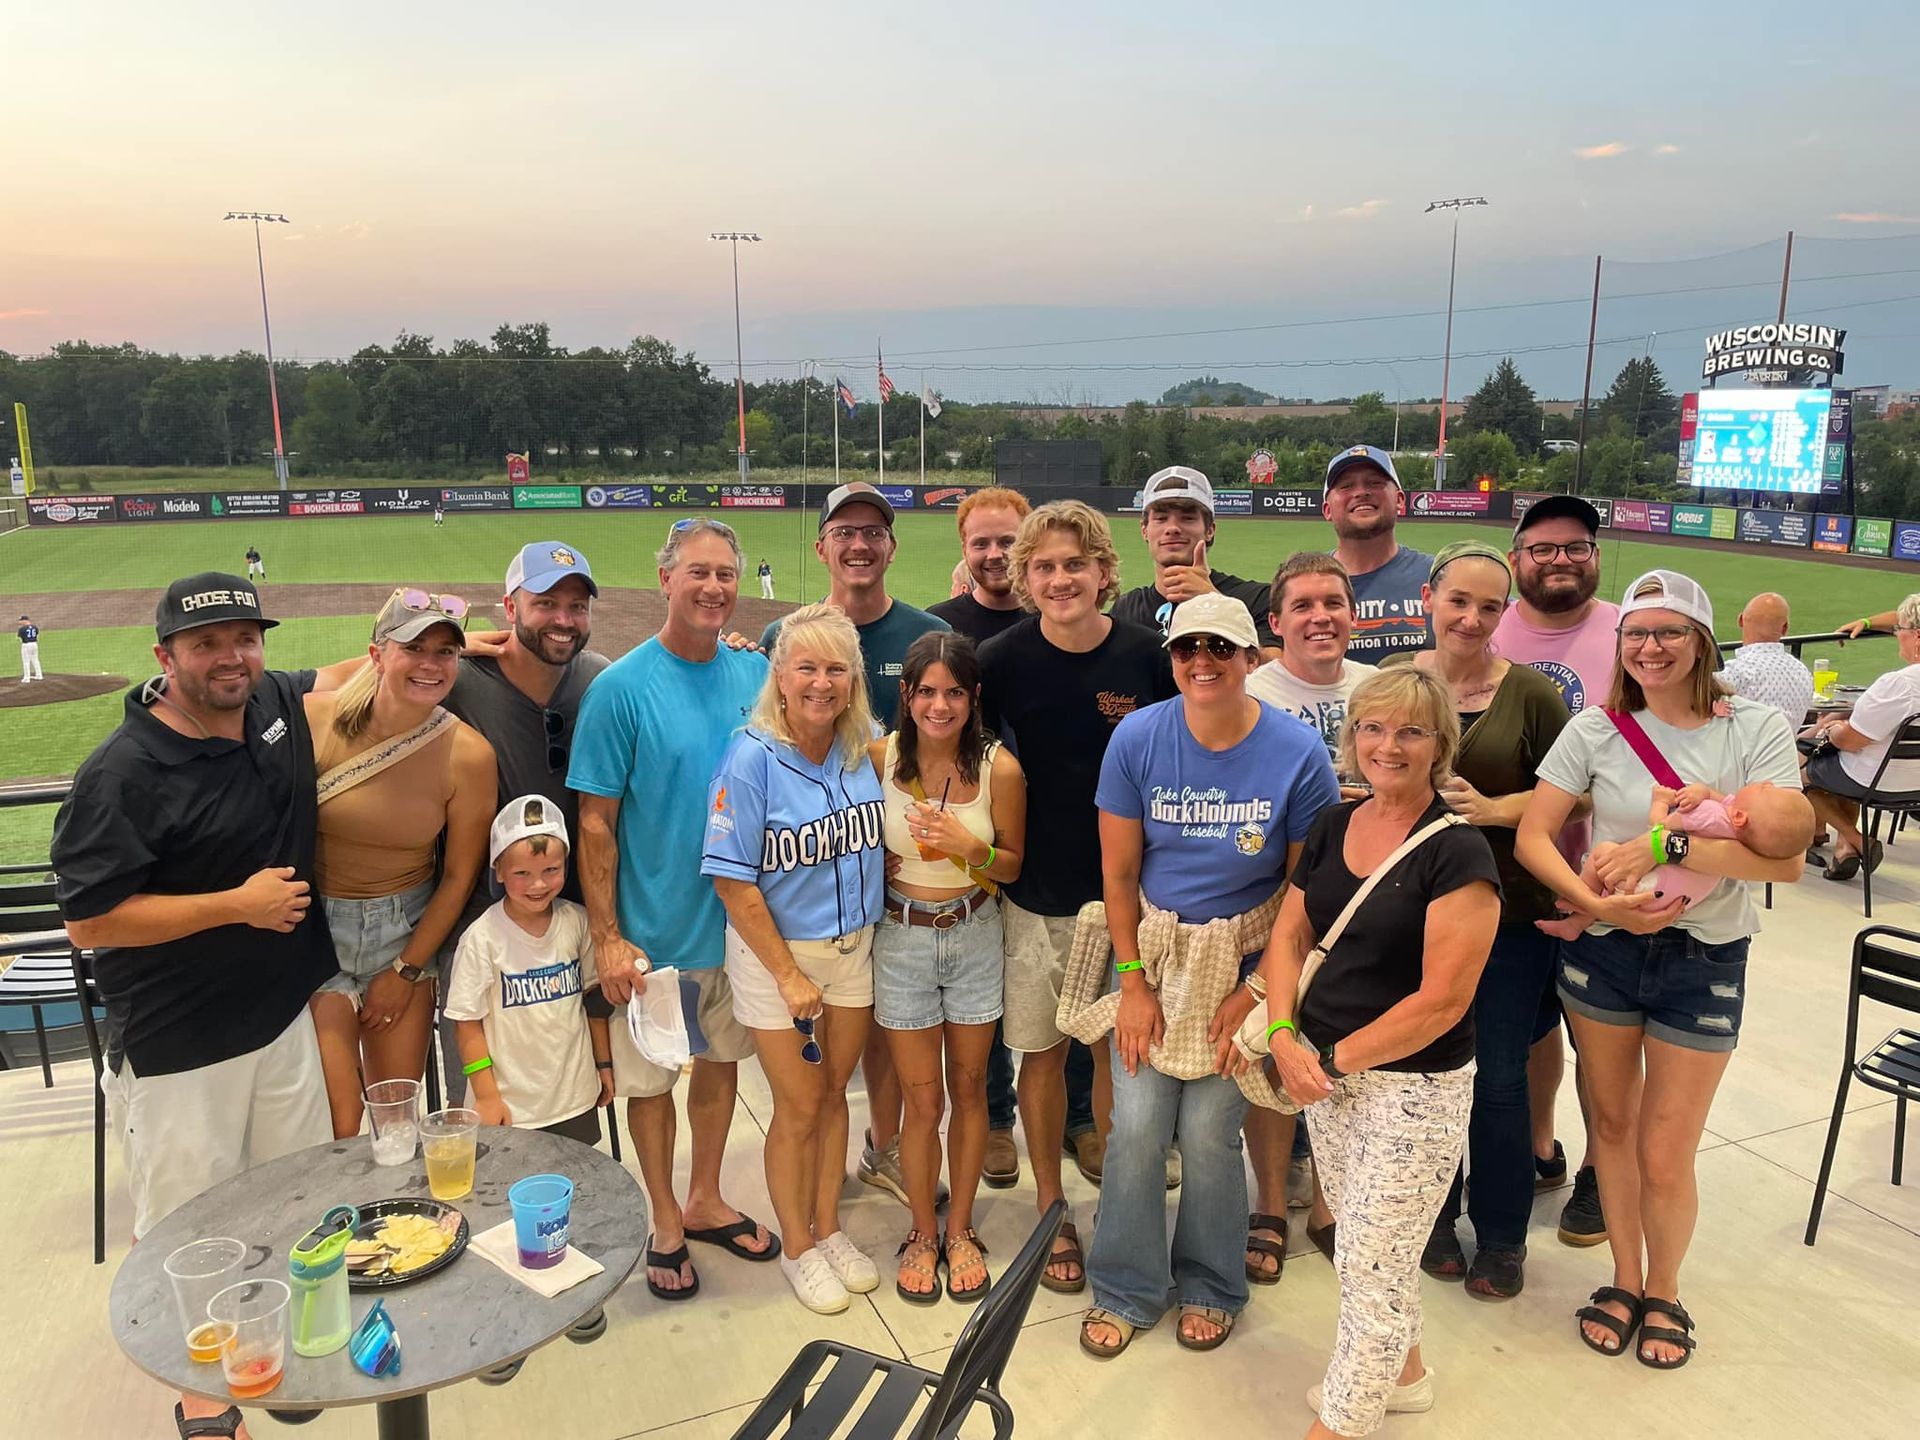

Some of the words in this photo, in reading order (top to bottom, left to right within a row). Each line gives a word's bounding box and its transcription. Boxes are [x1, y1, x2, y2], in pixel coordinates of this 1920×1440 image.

[1705, 324, 1836, 353] WISCONSIN
[1704, 349, 1803, 375] BREWING
[1807, 354, 1831, 370] CO.
[454, 491, 483, 501] Ixonia
[484, 490, 509, 501] Bank
[1263, 497, 1317, 507] DOBEL
[124, 501, 156, 511] Coors
[163, 500, 200, 513] Modelo
[304, 503, 360, 513] BOUCHER.COM
[181, 590, 233, 612] CHOOSE
[232, 591, 257, 609] FUN
[1530, 662, 1578, 686] DENTIAL
[1571, 692, 1583, 715] ARD
[1181, 786, 1228, 804] Country
[762, 800, 886, 873] DOCKHOU
[1182, 824, 1228, 839] baseball
